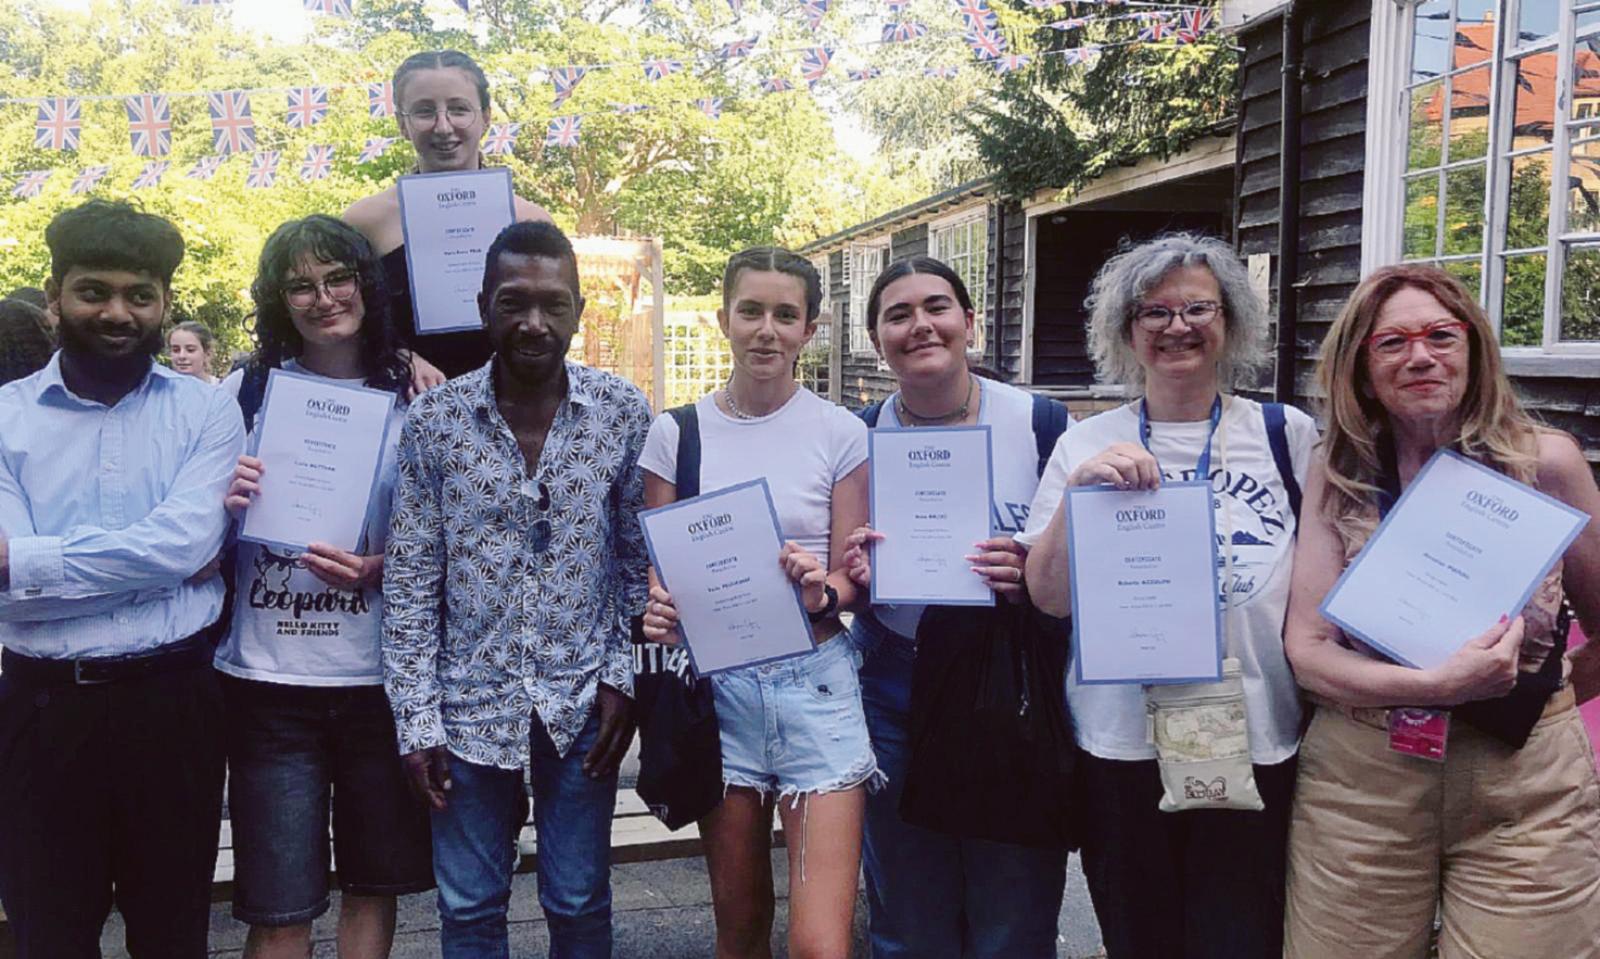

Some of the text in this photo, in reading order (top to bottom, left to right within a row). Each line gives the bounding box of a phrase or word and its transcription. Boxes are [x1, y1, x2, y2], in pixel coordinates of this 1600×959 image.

[437, 190, 476, 202] OXFORD
[306, 398, 351, 416] OXFORD
[908, 449, 951, 461] OXFORD
[1466, 490, 1520, 522] OXFORD
[1116, 509, 1166, 522] OXFORD
[687, 513, 732, 535] OXFORD
[249, 578, 370, 619] Leopard
[277, 620, 340, 629] HELLO KITTY
[300, 629, 340, 637] FRIENDS
